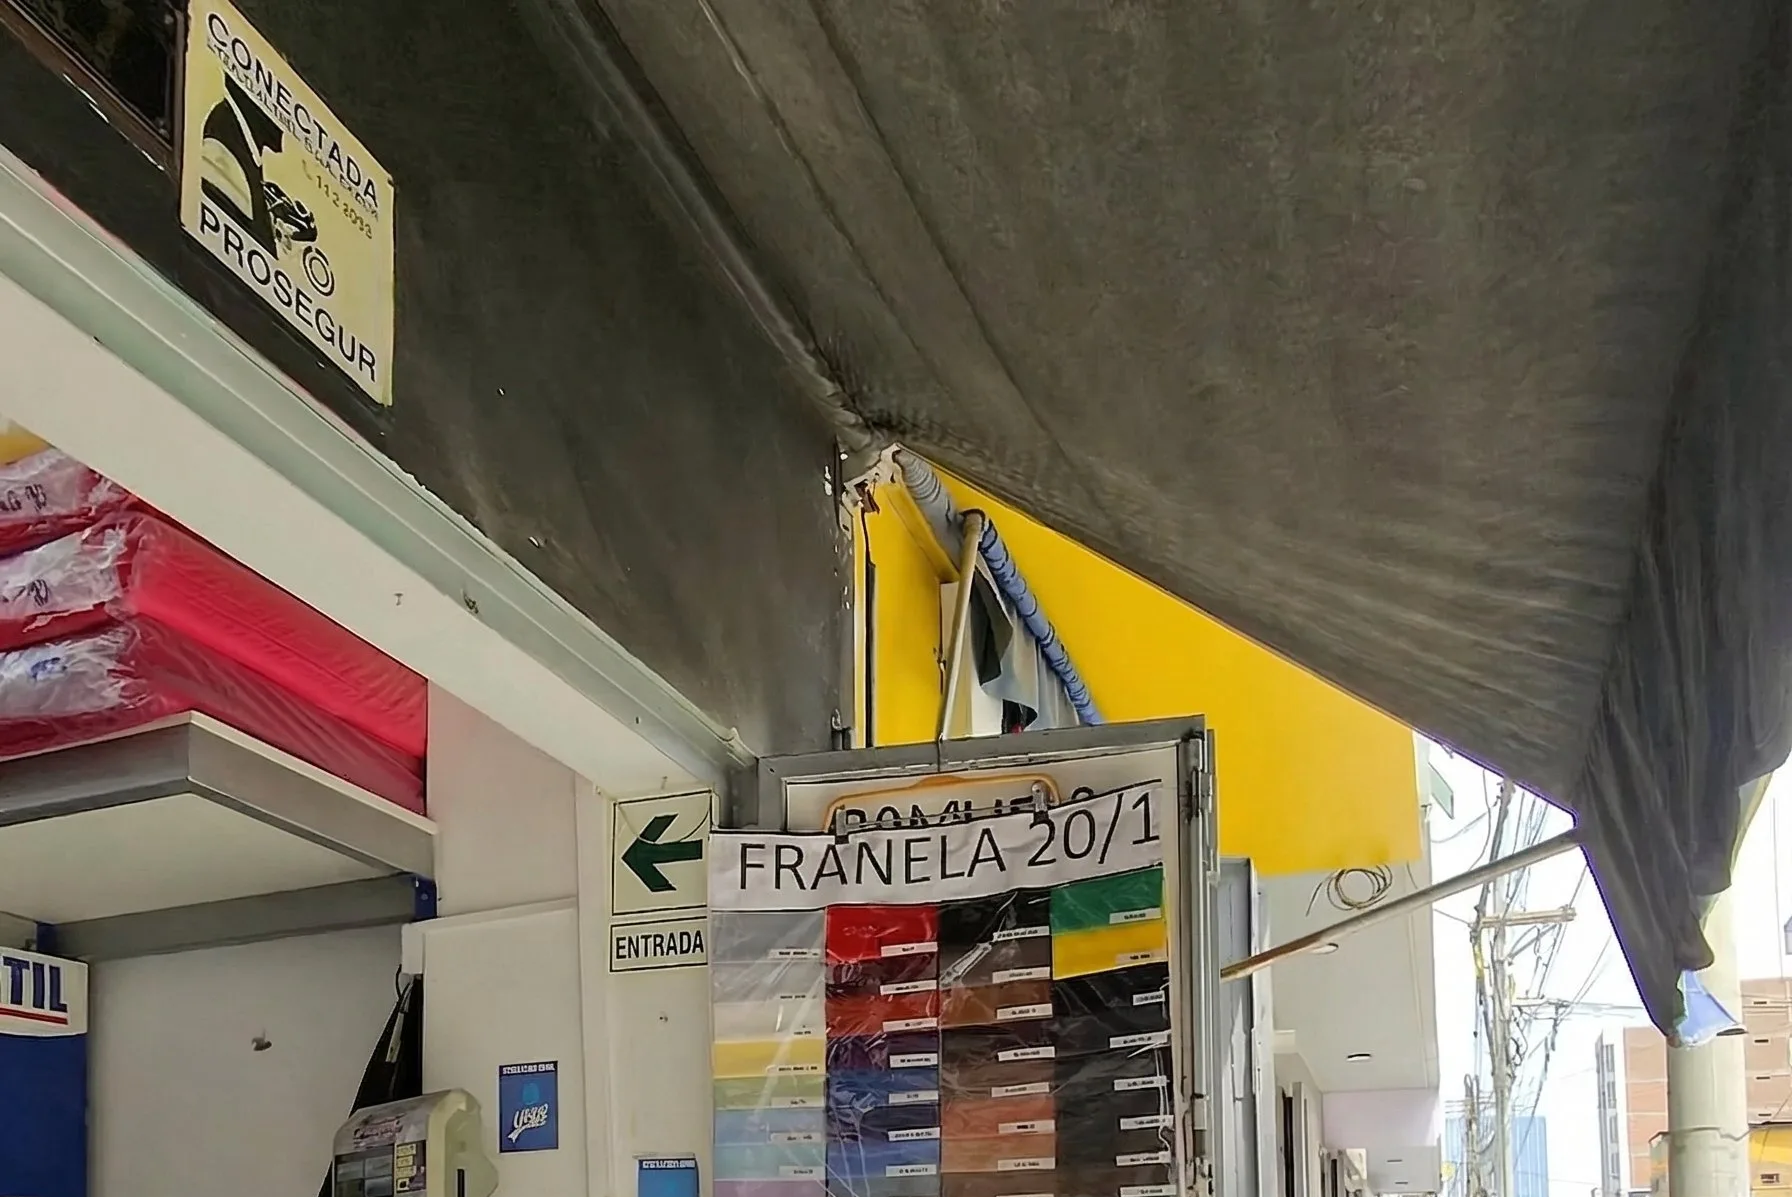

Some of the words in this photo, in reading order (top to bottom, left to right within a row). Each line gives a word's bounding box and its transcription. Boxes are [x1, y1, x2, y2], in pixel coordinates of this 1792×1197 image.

[206, 12, 378, 207] CONECTADA
[200, 202, 377, 384] PROSEGUR
[740, 827, 1007, 890] FRANELA
[1028, 793, 1160, 866] 20/1
[2, 955, 68, 1013] TIL
[615, 931, 704, 959] ENTRADA
